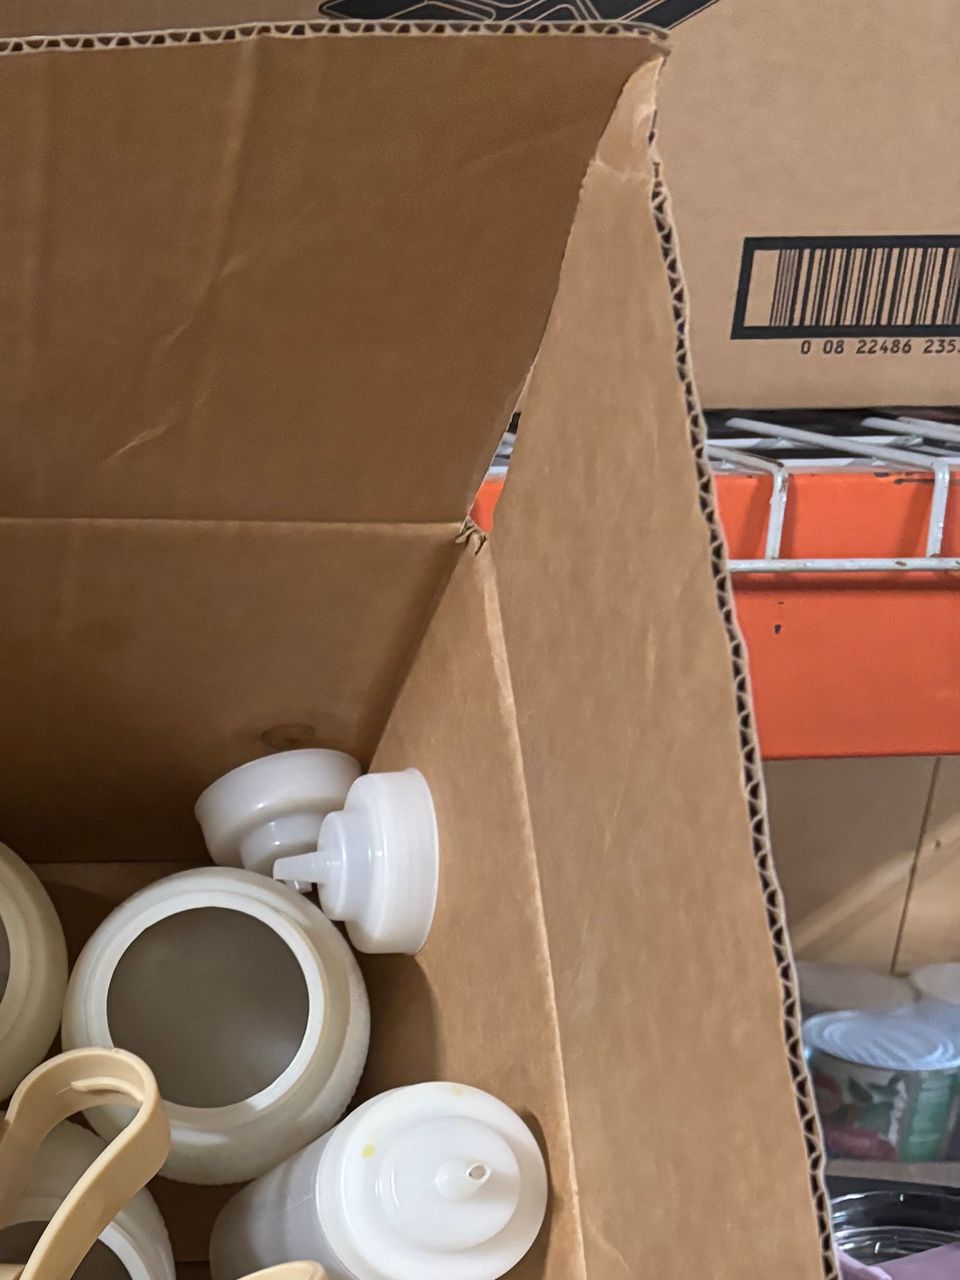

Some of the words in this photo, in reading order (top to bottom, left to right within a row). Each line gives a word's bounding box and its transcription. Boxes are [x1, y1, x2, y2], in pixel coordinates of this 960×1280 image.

[823, 340, 844, 354] 08
[856, 339, 912, 354] 22486
[923, 339, 960, 353] 235
